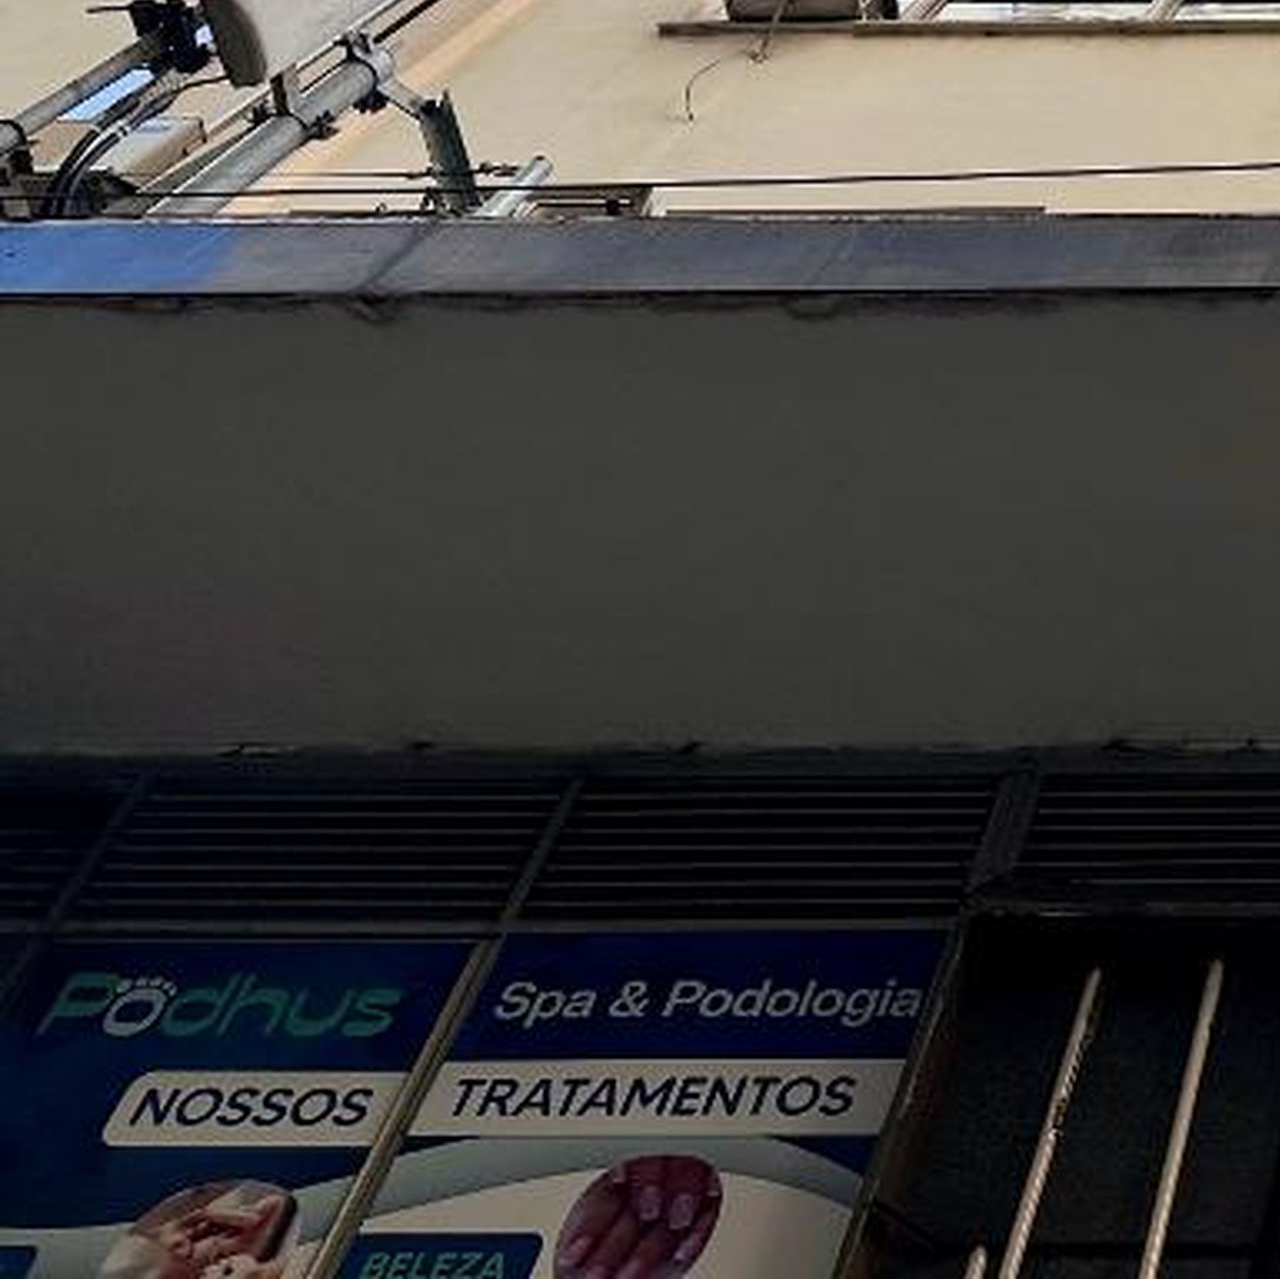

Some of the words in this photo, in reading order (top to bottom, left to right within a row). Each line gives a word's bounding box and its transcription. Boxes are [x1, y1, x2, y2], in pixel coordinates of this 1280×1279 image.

[36, 969, 403, 1038] Podhus
[495, 979, 593, 1026] Spa
[608, 979, 648, 1017] &
[661, 978, 926, 1027] Podologia
[129, 1088, 374, 1127] NOSSOS
[452, 1075, 857, 1117] TRATAMENTOS
[360, 1251, 504, 1279] BELEZA
